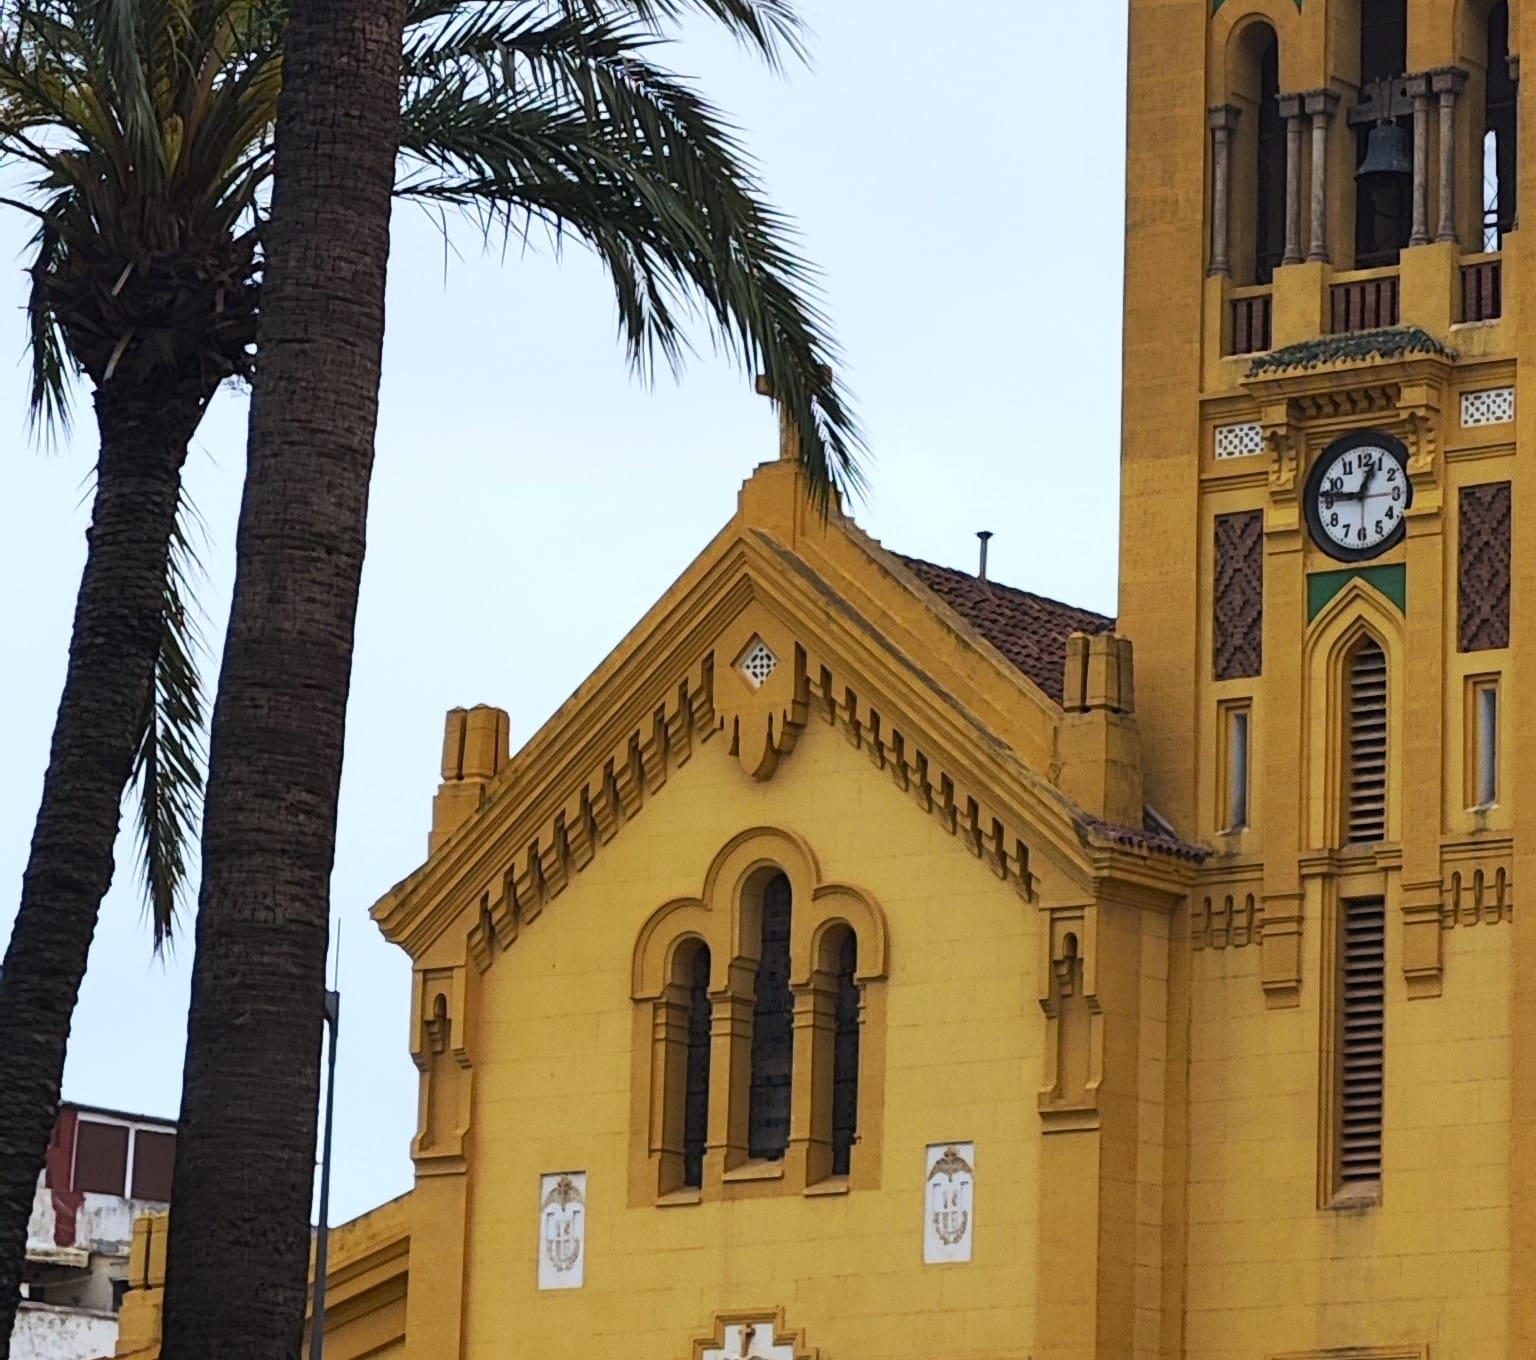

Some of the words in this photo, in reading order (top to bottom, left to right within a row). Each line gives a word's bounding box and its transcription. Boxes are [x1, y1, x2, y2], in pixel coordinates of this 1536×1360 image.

[1358, 453, 1372, 468] 12
[1378, 456, 1383, 471] 1
[1343, 461, 1353, 475] 11
[1387, 468, 1396, 482] 2
[1330, 477, 1343, 491] 10
[1392, 486, 1400, 501] 3
[1330, 512, 1338, 527] 8
[1385, 506, 1394, 520] 4
[1342, 524, 1351, 538] 7
[1358, 526, 1367, 541] 6
[1375, 520, 1383, 534] 5
